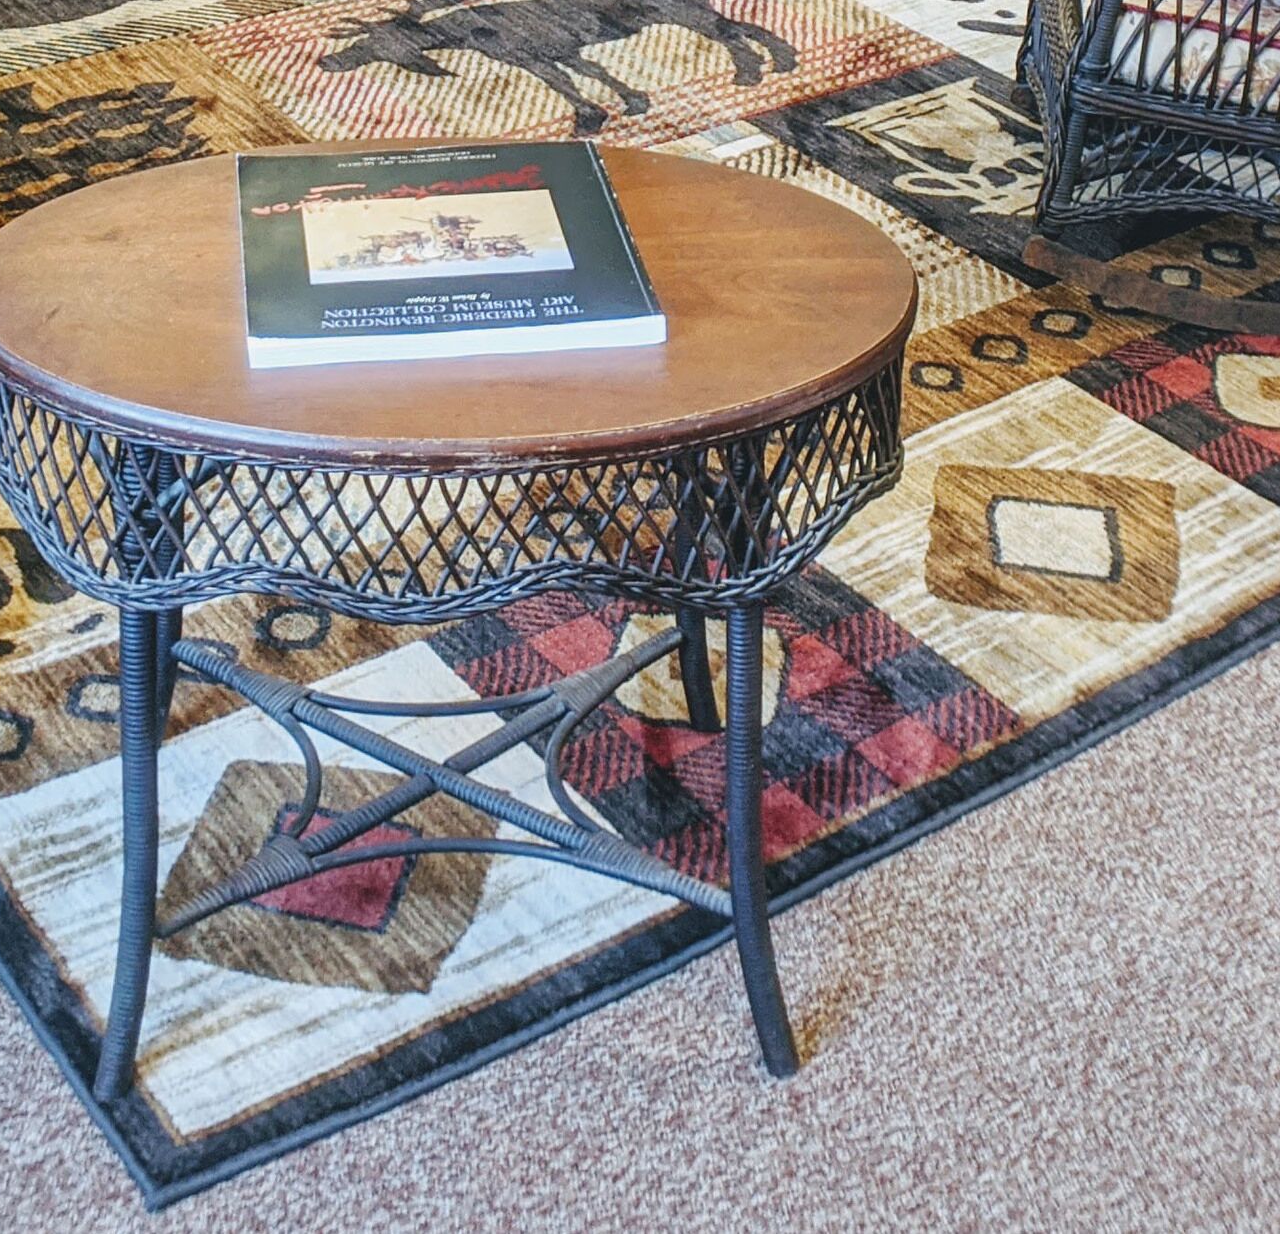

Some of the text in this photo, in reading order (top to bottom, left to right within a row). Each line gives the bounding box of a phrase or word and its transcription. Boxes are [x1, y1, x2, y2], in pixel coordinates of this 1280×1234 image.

[321, 306, 584, 329] THE FREDERIC REMINGTON
[323, 295, 575, 319] ART MUSEUM COLLECTION
